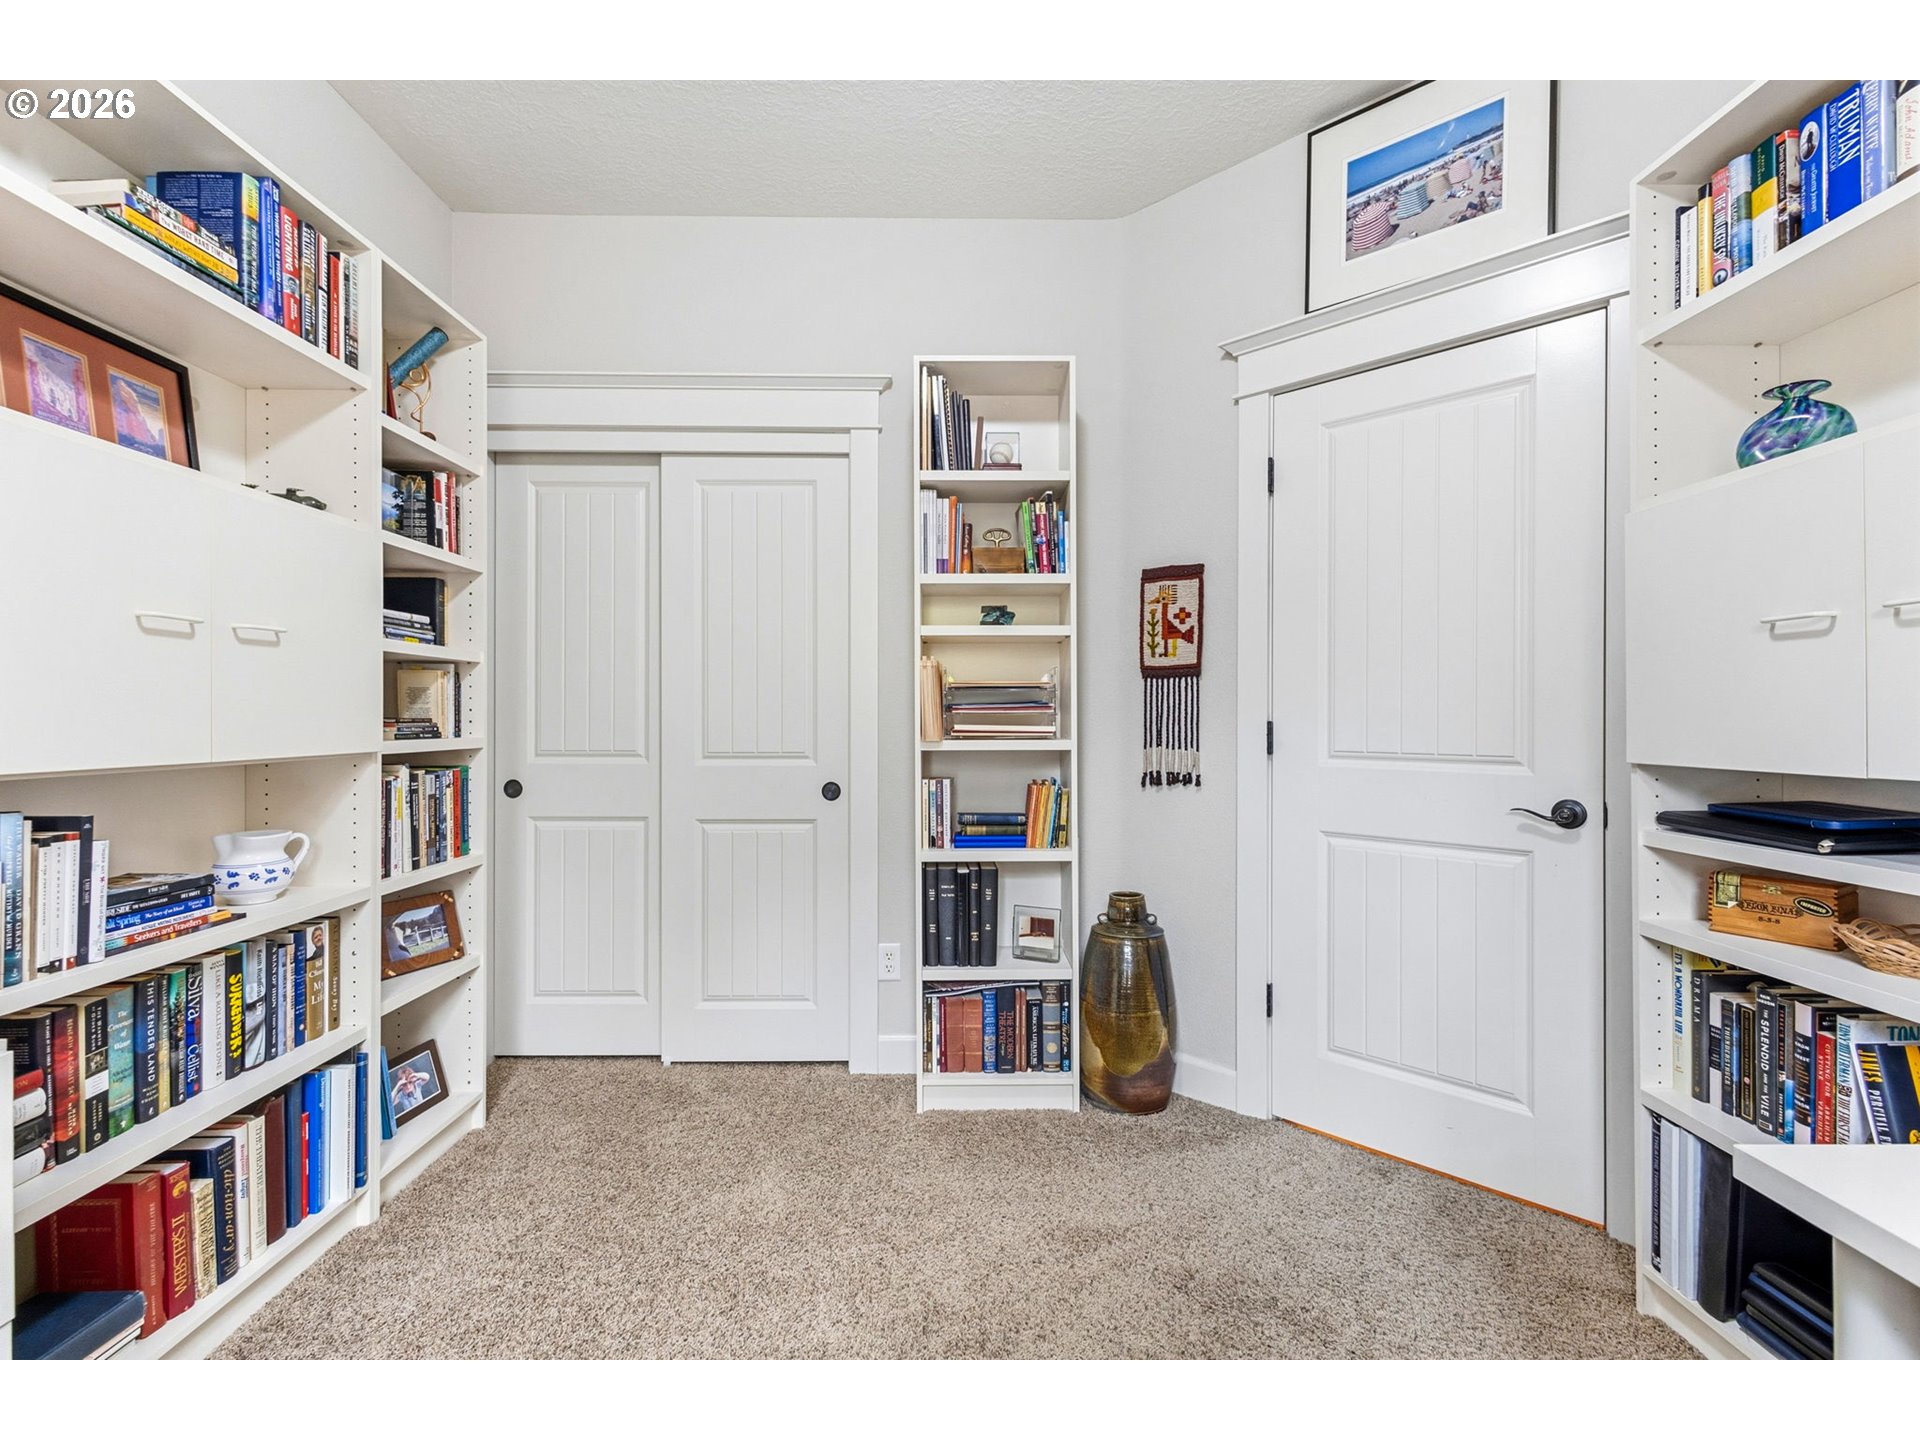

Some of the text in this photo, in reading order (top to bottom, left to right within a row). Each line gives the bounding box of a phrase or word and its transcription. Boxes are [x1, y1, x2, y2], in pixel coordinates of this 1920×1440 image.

[1838, 88, 1861, 168] TRUMAN
[1714, 191, 1726, 213] THE
[171, 221, 192, 239] WORST
[193, 234, 208, 249] HARD
[210, 243, 224, 257] TIME
[283, 214, 293, 272] LIGHTNING
[1713, 211, 1727, 250] UNLIKELY
[1714, 248, 1727, 266] SPY
[115, 913, 141, 929] Spring
[134, 917, 203, 943] Seekers and Travellers
[188, 975, 201, 1021] Silva
[330, 999, 338, 1014] Boy
[1674, 973, 1683, 1017] WONDERFUL
[117, 1010, 128, 1018] The
[147, 981, 156, 1082] THIS TENDER LAND
[998, 1011, 1006, 1045] THEATRE
[1674, 1018, 1683, 1034] LIFE
[1006, 1011, 1014, 1059] THE MODERN
[1760, 1019, 1769, 1070] SPLENDID
[1839, 1023, 1851, 1043] TONY
[187, 1044, 200, 1083] Cellist
[1838, 1042, 1851, 1085] HILLERMAN
[1858, 1049, 1883, 1083] JAMES
[1760, 1094, 1769, 1118] VILE
[1824, 1080, 1832, 1098] FOR
[1824, 1105, 1832, 1142] ABRAHAM
[1838, 1108, 1850, 1131] FIRST
[171, 1212, 187, 1298] WEBSTER'S II
